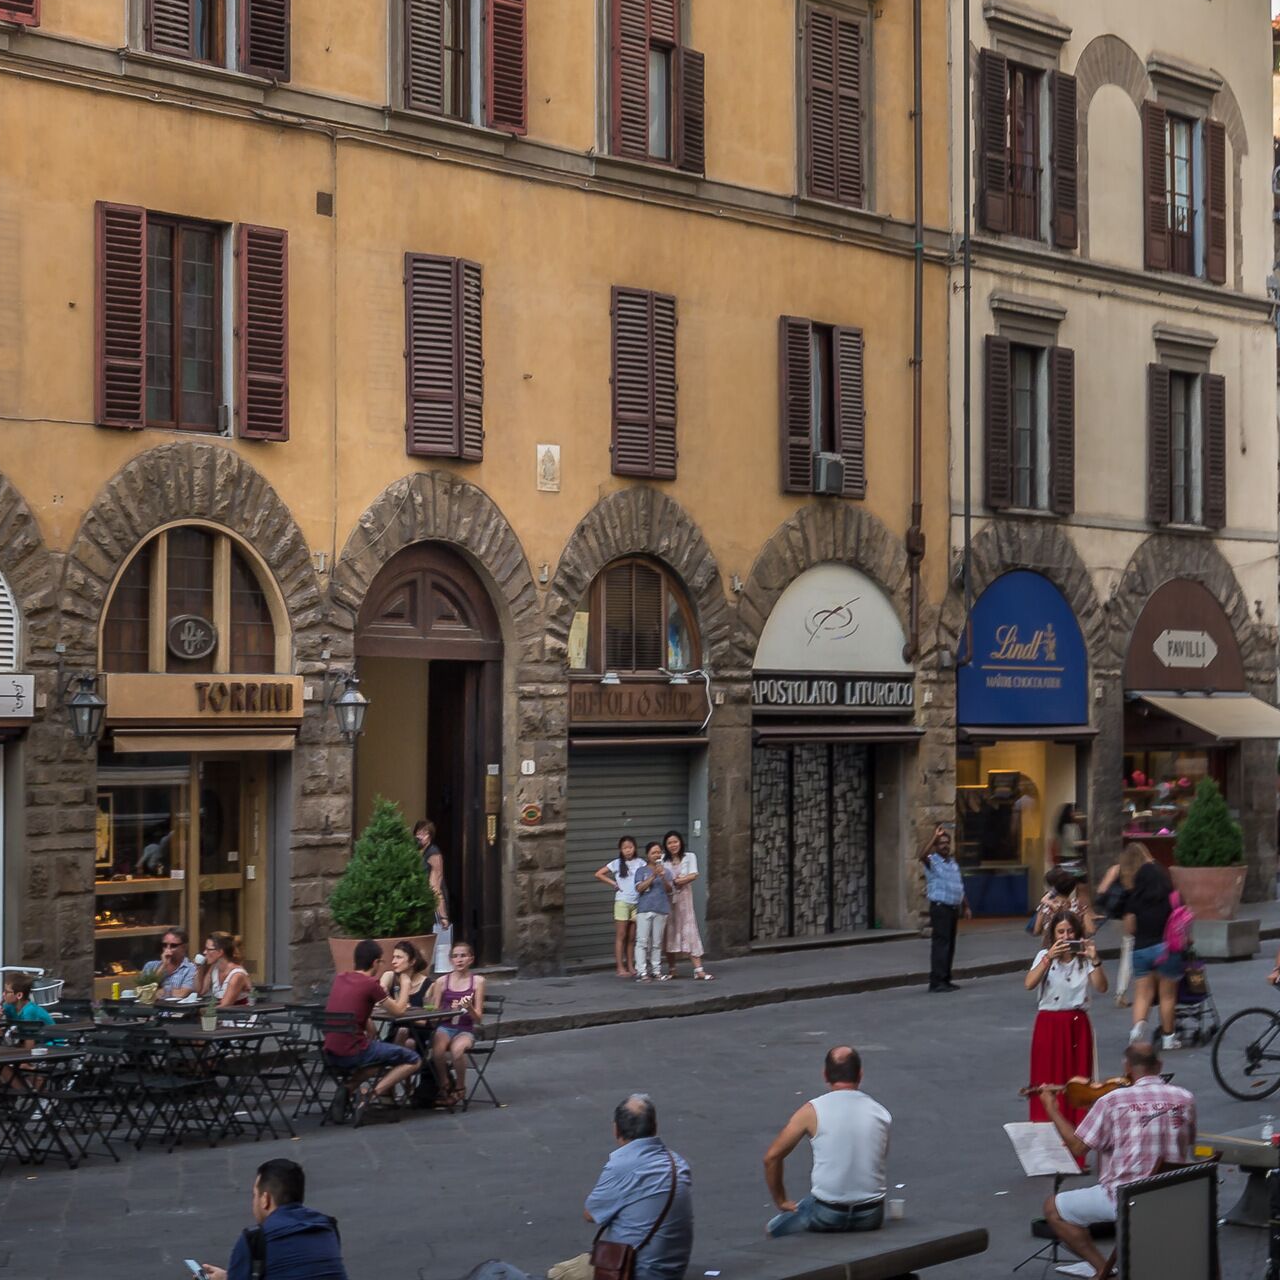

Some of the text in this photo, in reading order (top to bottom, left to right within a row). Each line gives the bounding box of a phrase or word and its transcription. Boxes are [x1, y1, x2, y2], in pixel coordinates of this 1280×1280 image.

[990, 624, 1047, 661] Lindt
[1167, 639, 1206, 658] FAVILLI
[194, 681, 294, 713] TORRINI
[655, 690, 693, 717] SHOP
[752, 679, 913, 706] APOSTOLATO LITURGICO
